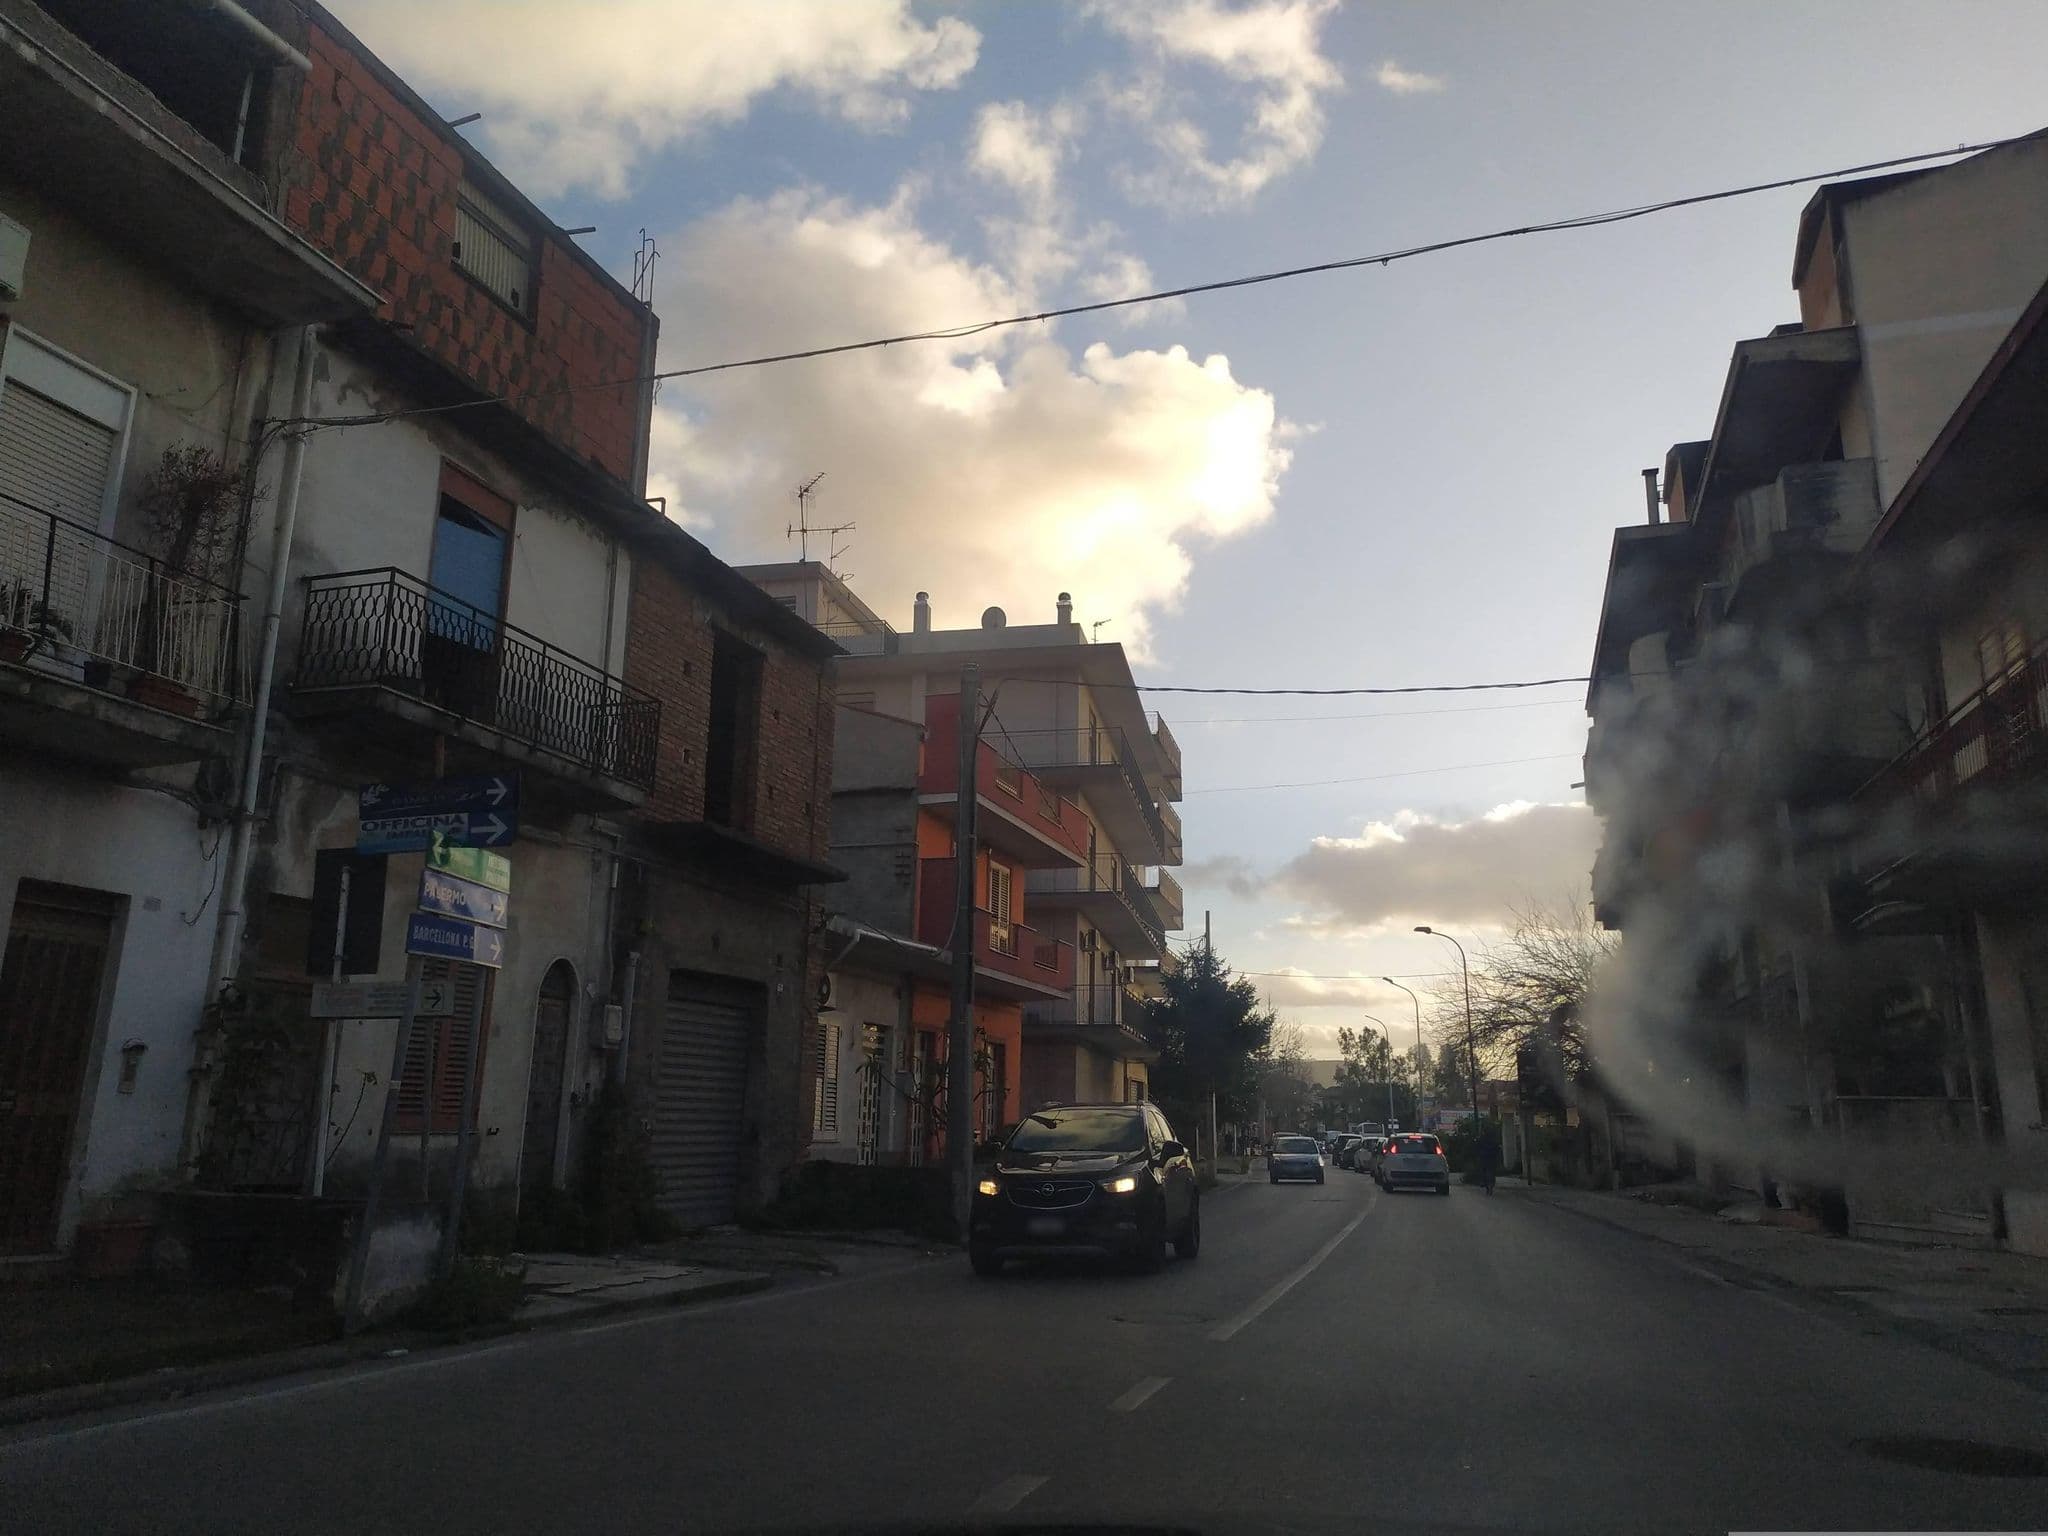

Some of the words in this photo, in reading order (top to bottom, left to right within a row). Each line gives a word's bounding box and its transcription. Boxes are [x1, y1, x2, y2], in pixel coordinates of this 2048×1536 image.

[361, 815, 465, 832] OFFICINA
[424, 880, 466, 906] PALERMO
[413, 925, 460, 945] BARCELLONA
